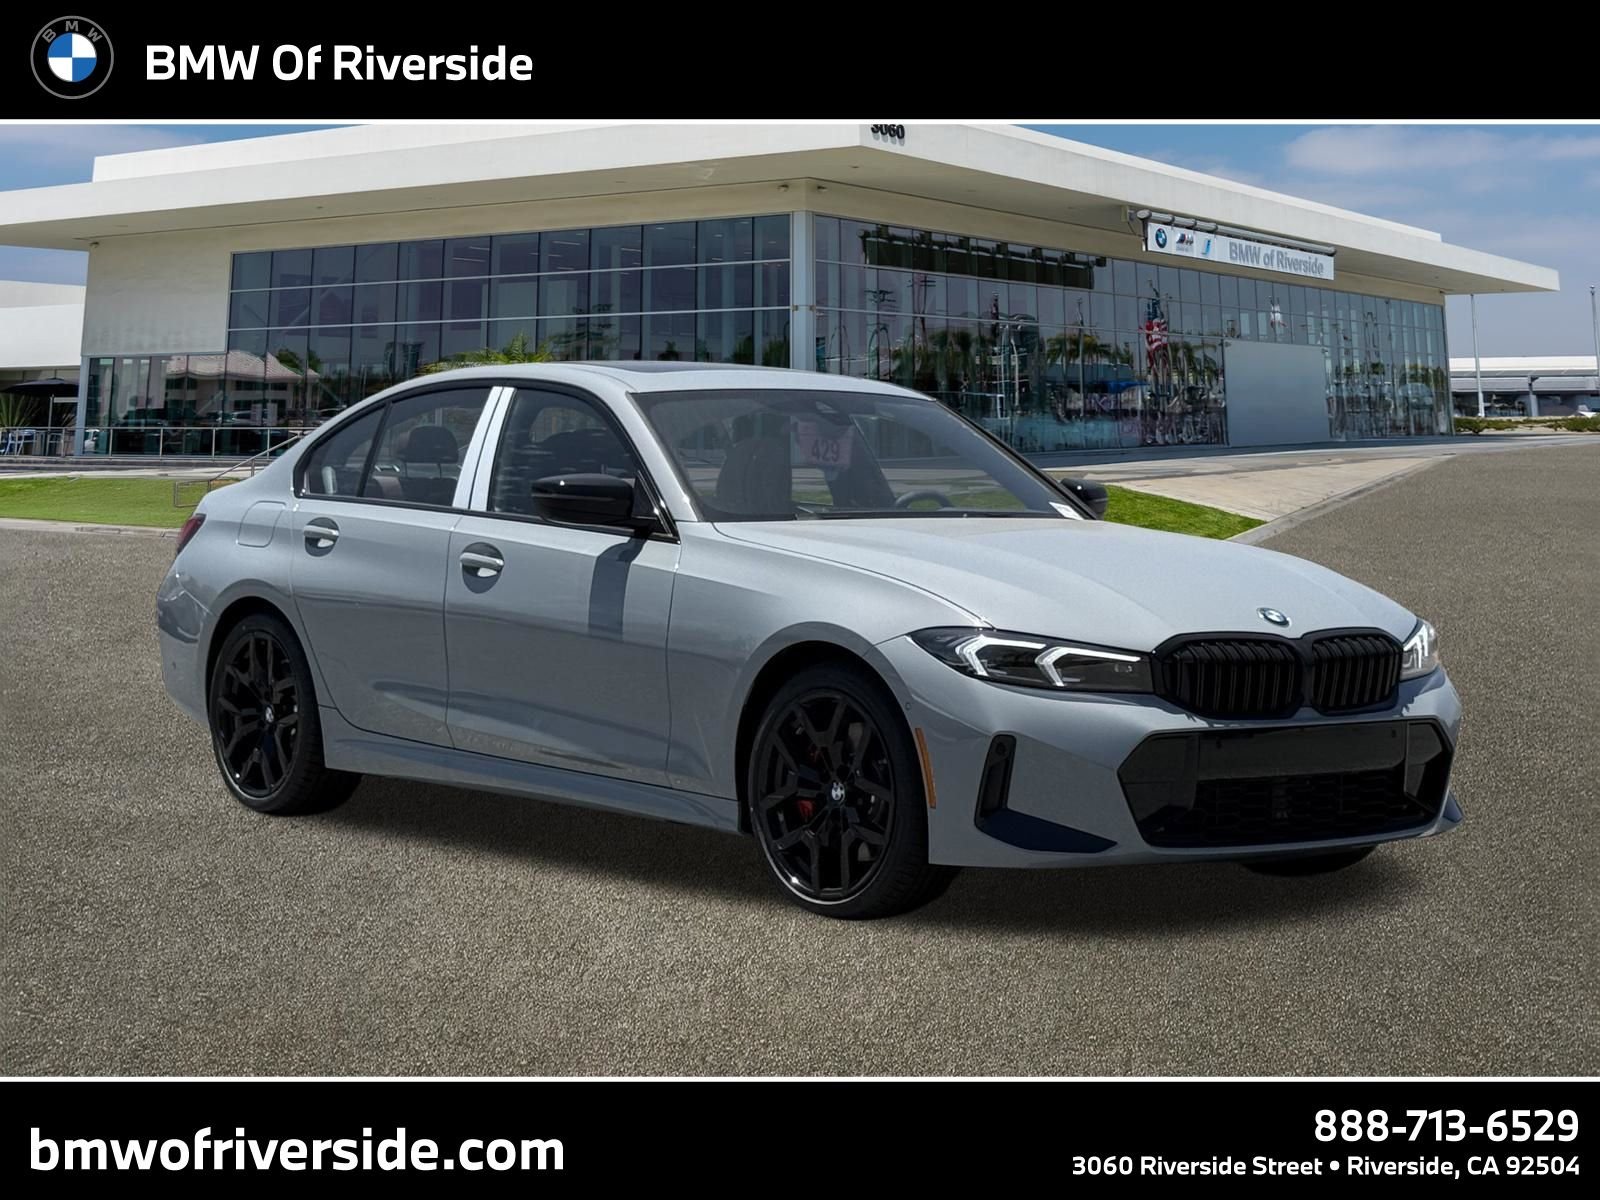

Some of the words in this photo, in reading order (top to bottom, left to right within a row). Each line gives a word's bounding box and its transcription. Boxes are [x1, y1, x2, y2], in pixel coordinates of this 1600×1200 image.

[1229, 241, 1261, 266] BMW
[1263, 248, 1275, 268] of
[1276, 251, 1324, 275] Riverside
[811, 439, 840, 462] 429
